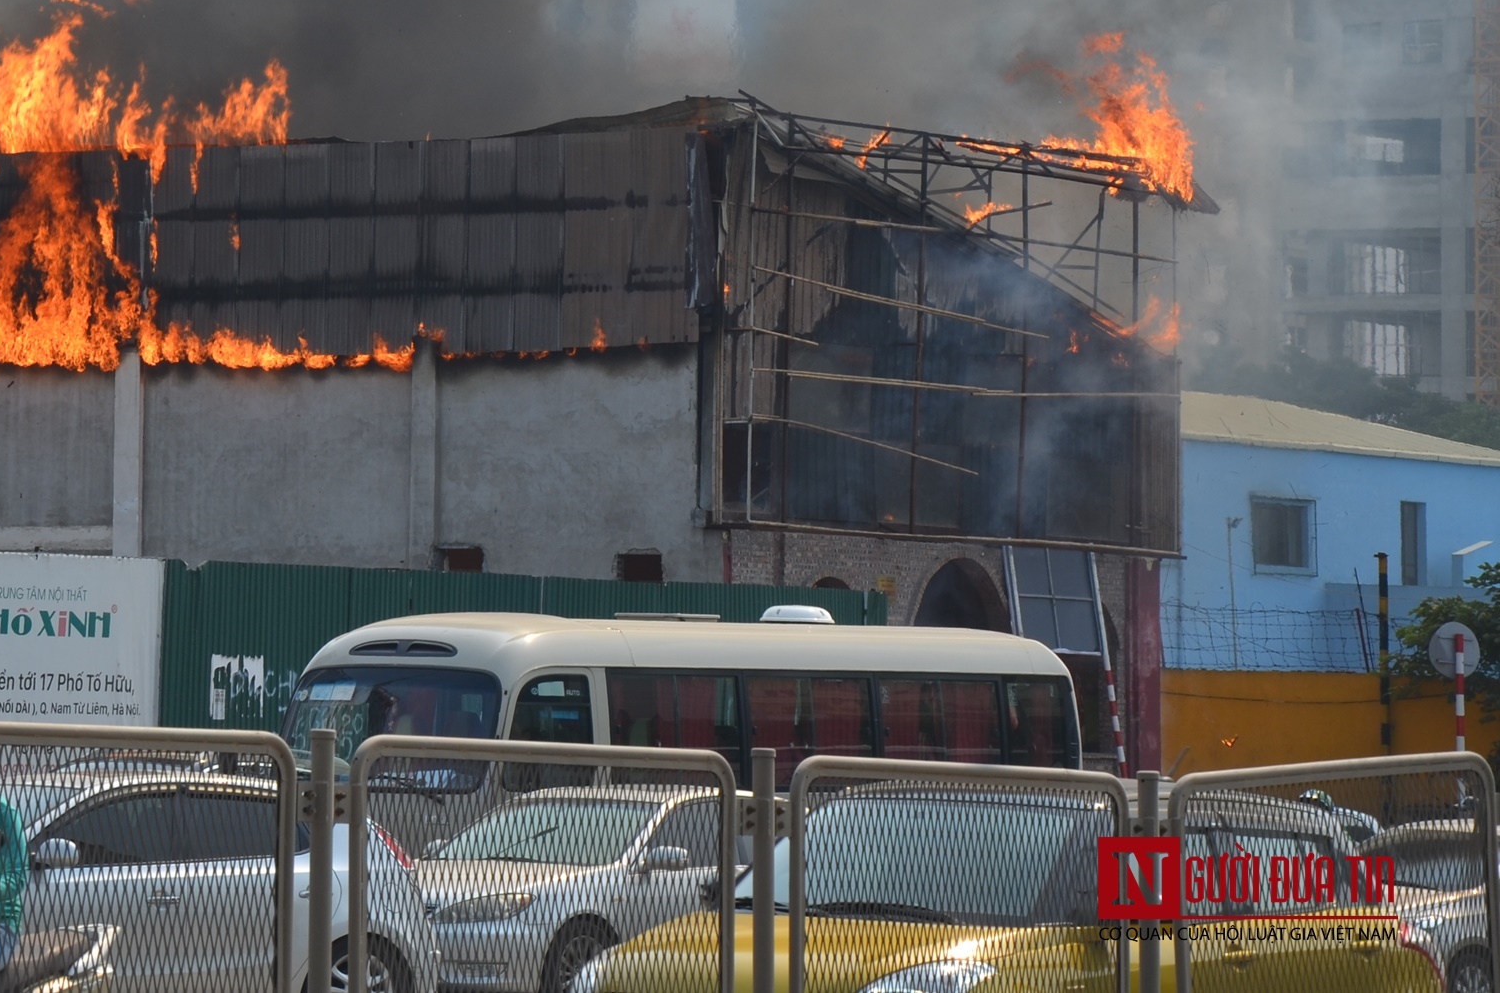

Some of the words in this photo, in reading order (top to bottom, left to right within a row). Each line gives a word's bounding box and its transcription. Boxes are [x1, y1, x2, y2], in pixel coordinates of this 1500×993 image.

[26, 585, 47, 601] TÂM
[48, 586, 65, 604] NỘI
[66, 585, 88, 602] THẤT
[18, 670, 37, 692] tới
[40, 673, 55, 691] 17
[57, 671, 85, 692] Phố
[86, 671, 103, 693] Tố
[104, 674, 134, 696] Hữu,
[40, 701, 49, 715] Q.
[50, 702, 72, 715] Nam
[73, 701, 86, 715] Từ
[86, 702, 110, 717] Liêm,
[111, 703, 124, 716] Hà
[125, 703, 141, 718] Nội.
